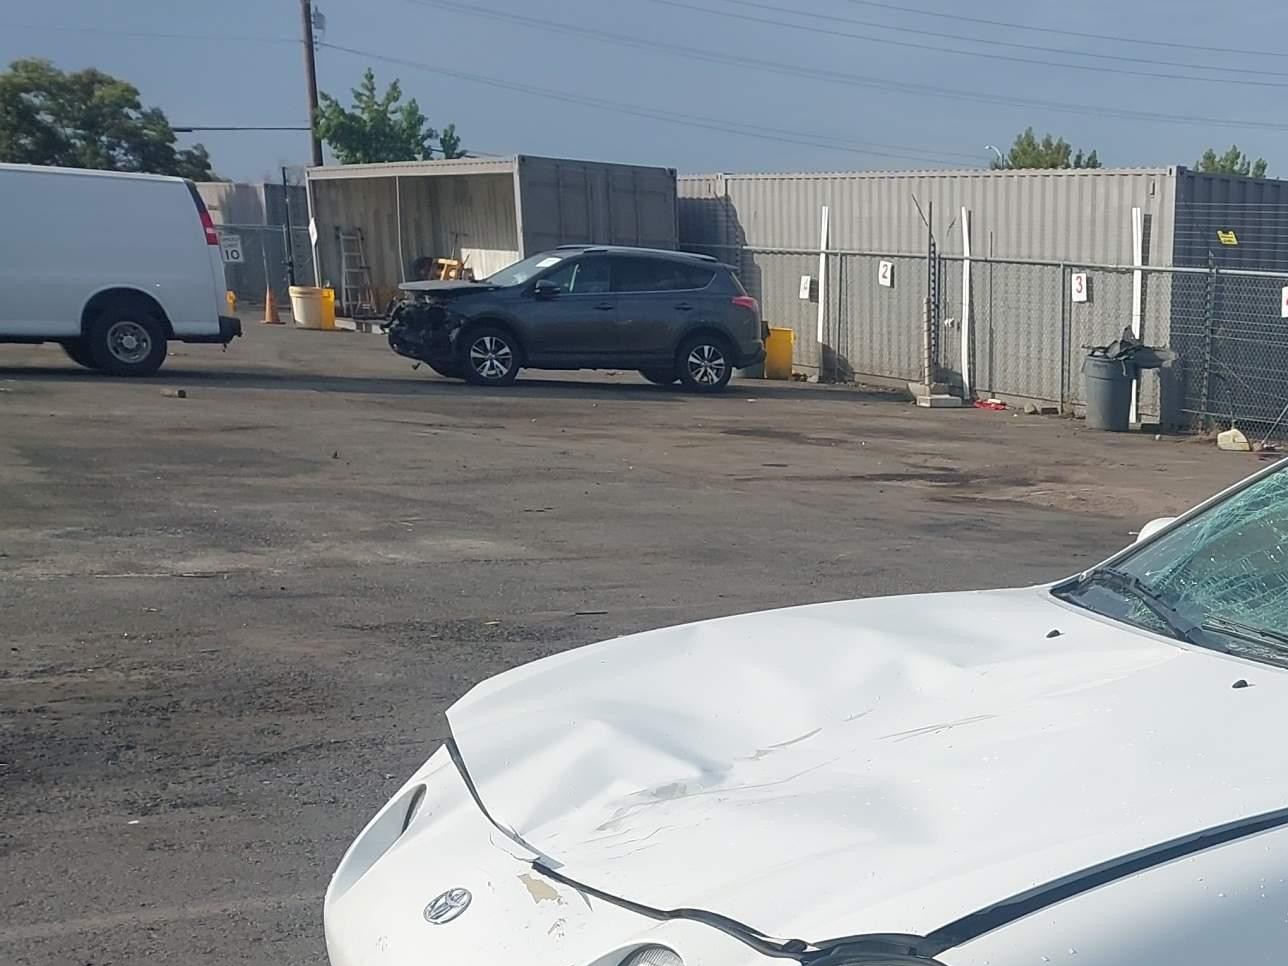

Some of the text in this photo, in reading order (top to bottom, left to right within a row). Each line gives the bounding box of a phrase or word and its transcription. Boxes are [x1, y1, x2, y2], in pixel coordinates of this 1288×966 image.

[225, 249, 240, 260] 10
[881, 264, 888, 279] 2
[1075, 275, 1083, 293] 3
